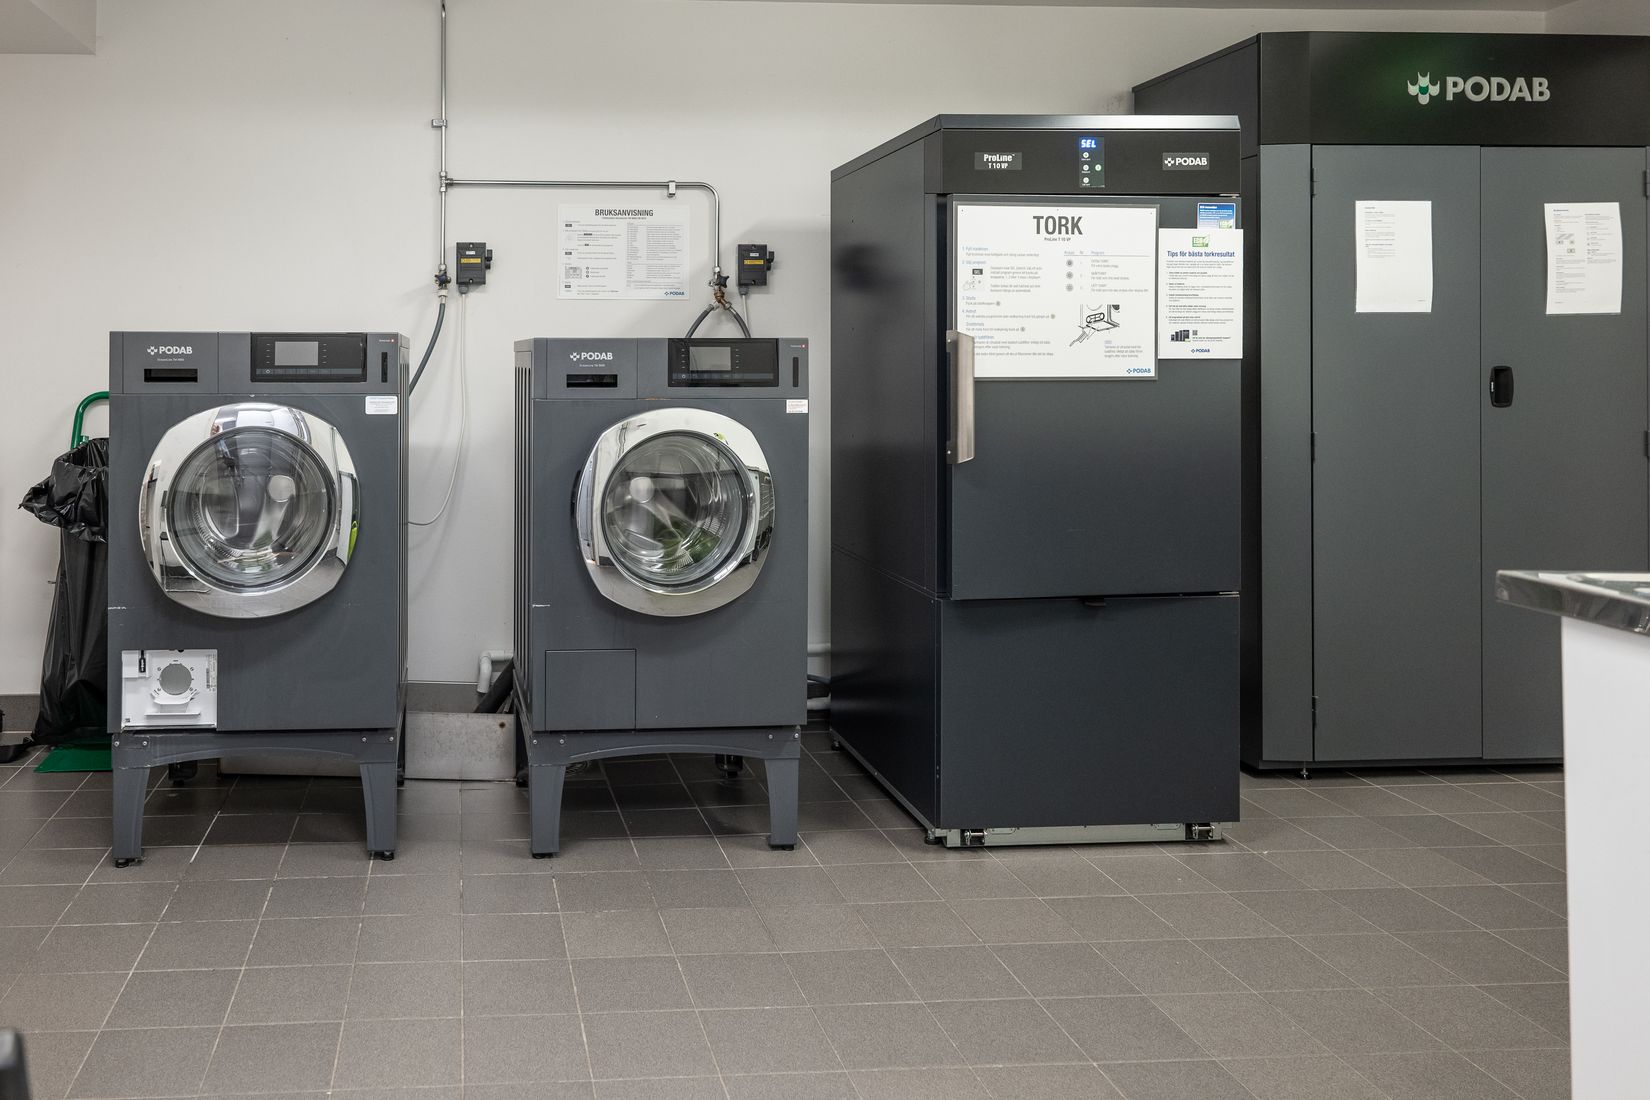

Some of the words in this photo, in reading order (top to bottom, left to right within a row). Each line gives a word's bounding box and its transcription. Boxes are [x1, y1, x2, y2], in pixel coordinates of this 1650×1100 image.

[1446, 76, 1551, 102] PODAB
[1081, 139, 1097, 148] SEL
[1175, 157, 1208, 166] PODAB
[595, 208, 654, 217] BRUKSANVISNING
[1032, 215, 1083, 236] TORK
[1167, 250, 1178, 259] Tips
[1179, 250, 1187, 258] för
[1188, 250, 1203, 258] bästa
[1204, 250, 1235, 258] torkresultat
[159, 346, 193, 354] PODAB
[581, 352, 613, 360] PODAB
